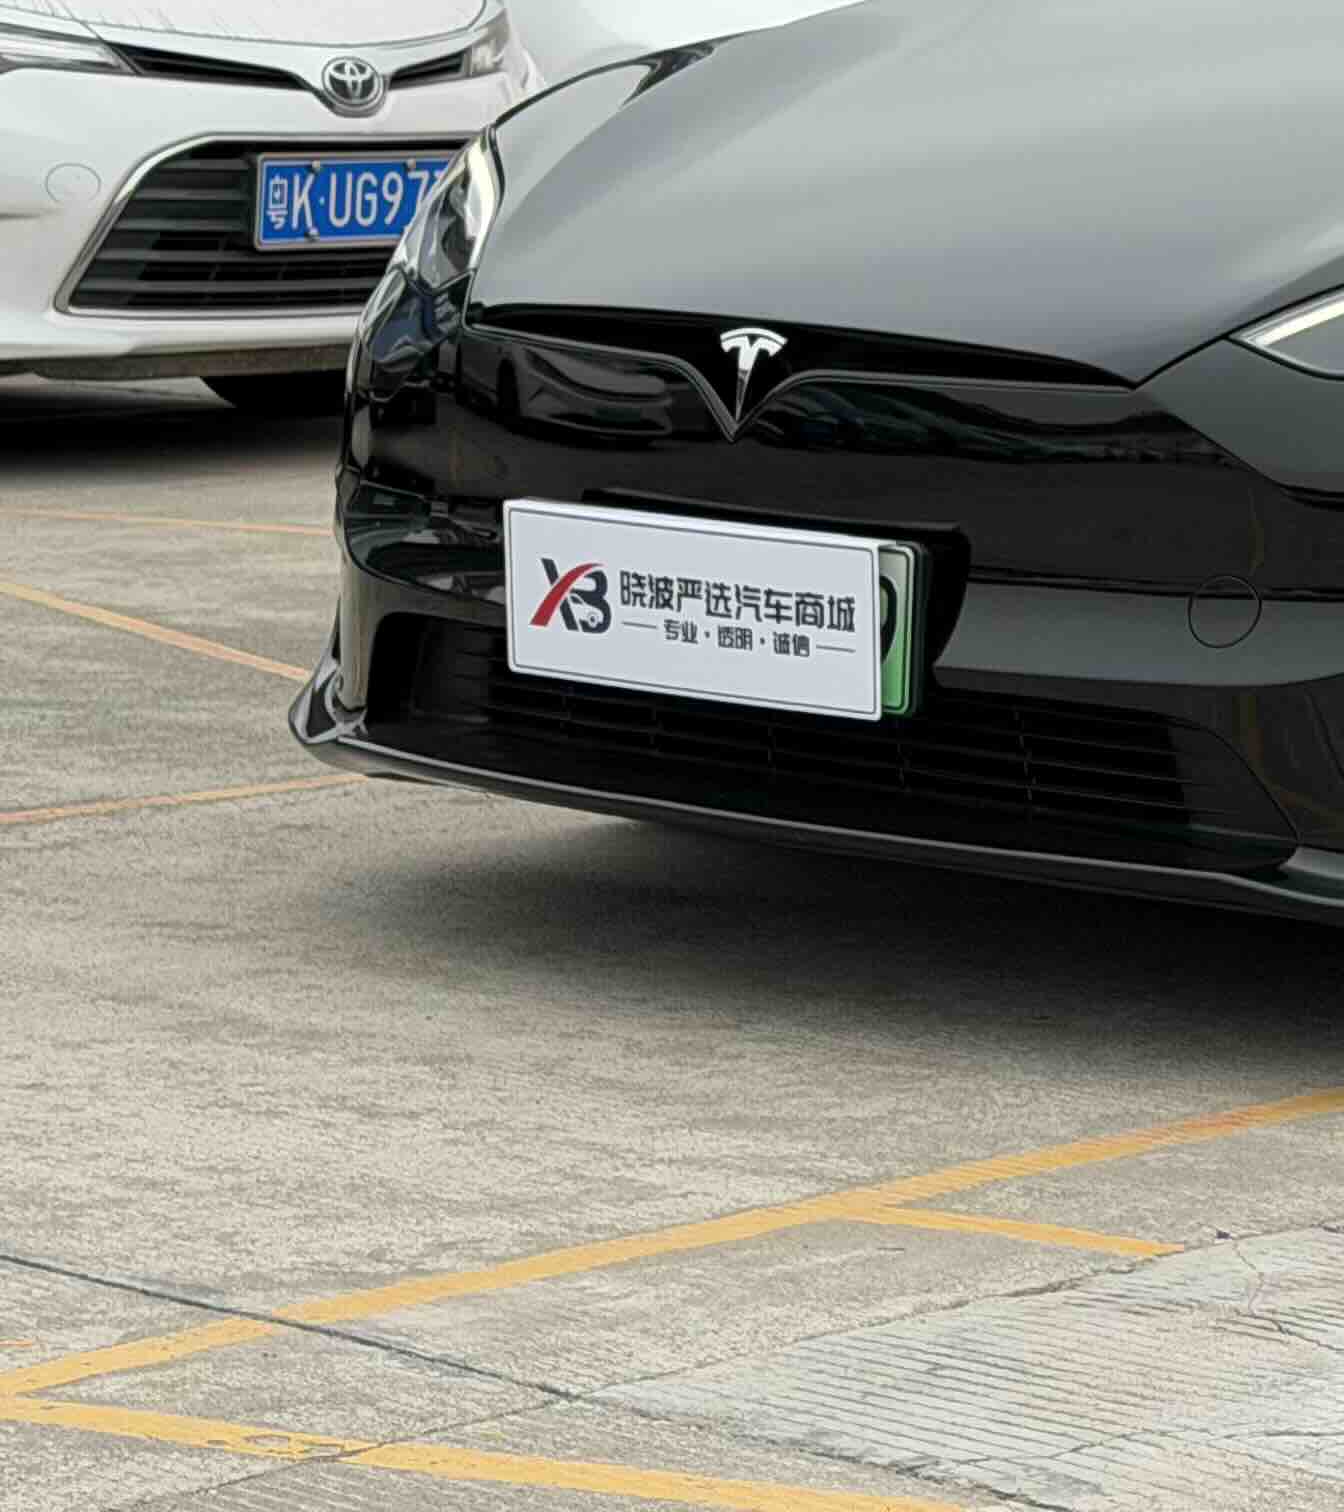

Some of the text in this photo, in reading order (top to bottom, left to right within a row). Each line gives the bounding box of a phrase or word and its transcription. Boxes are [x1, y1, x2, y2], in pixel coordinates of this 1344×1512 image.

[267, 171, 443, 230] 粤K·UG97
[619, 569, 856, 633] 晓波严选汽车商城
